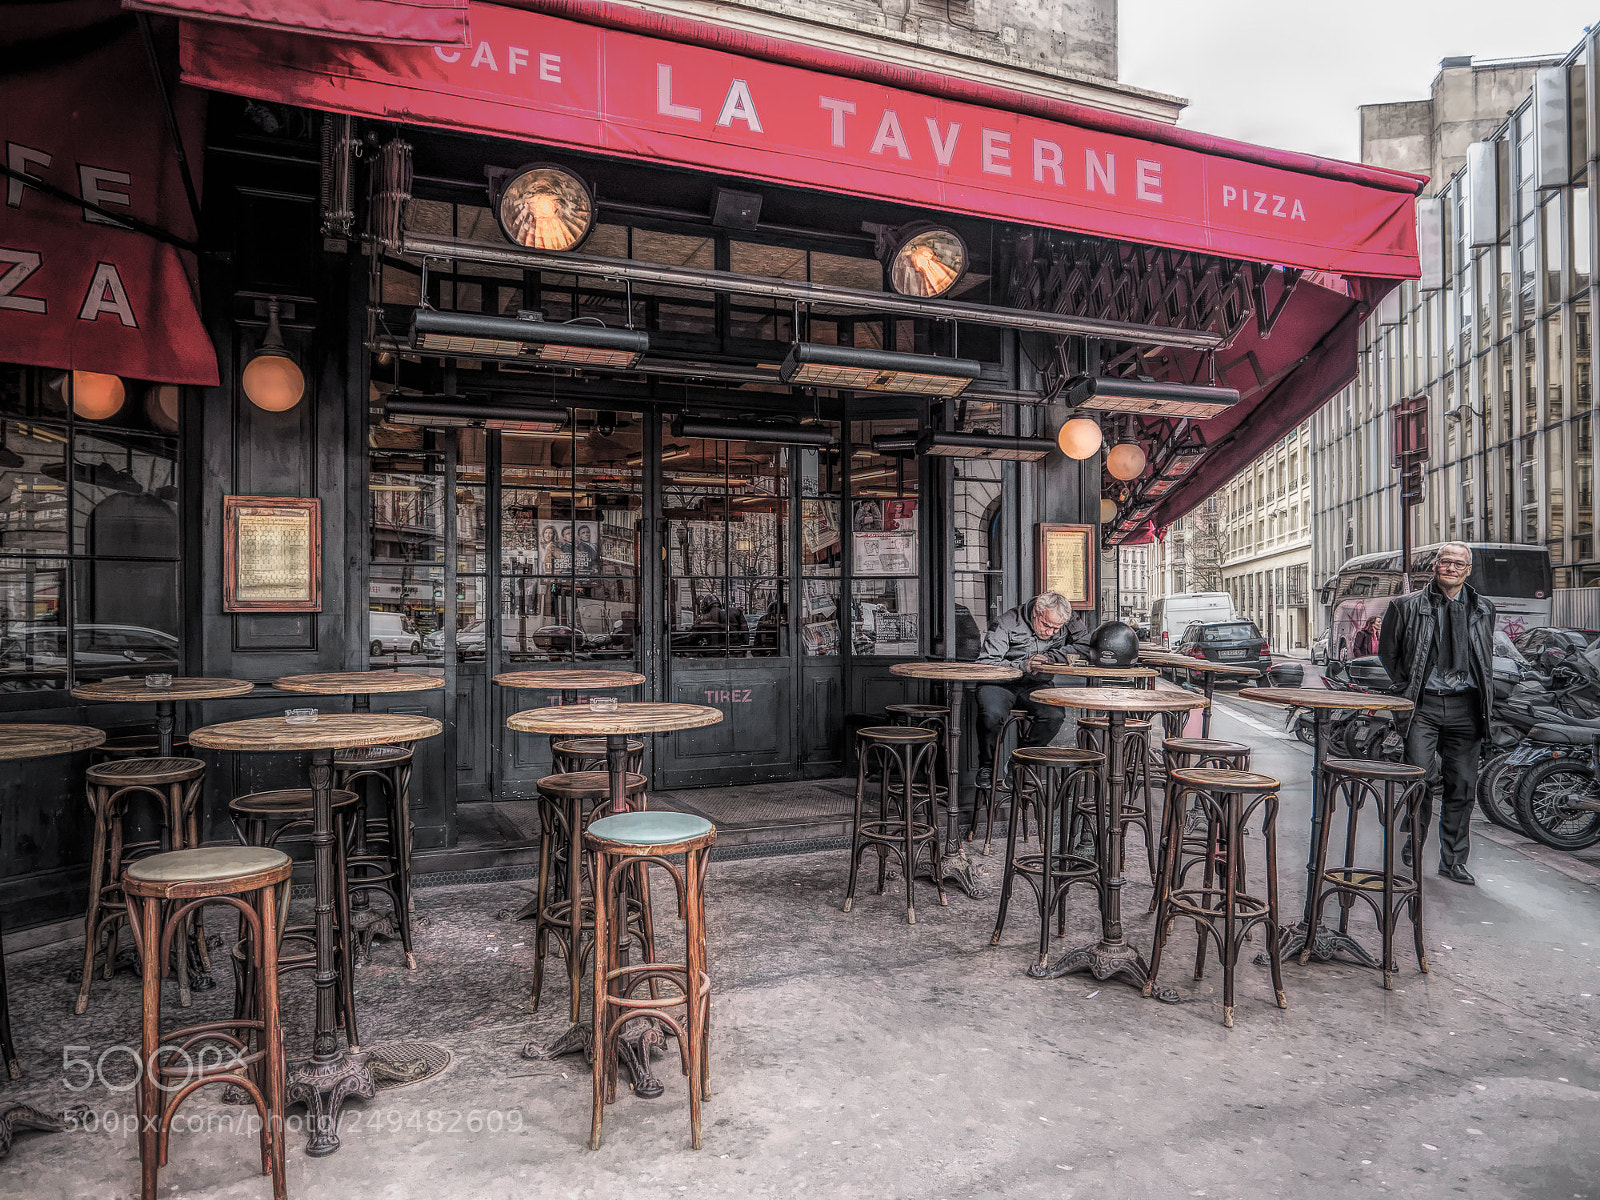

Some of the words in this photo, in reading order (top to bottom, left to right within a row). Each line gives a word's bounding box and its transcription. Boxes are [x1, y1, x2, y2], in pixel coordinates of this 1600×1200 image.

[656, 63, 764, 134] LA
[818, 96, 1164, 204] TAVERNE
[1222, 184, 1307, 223] PIZZA
[547, 694, 600, 707] TIE
[704, 689, 753, 704] TIREZ
